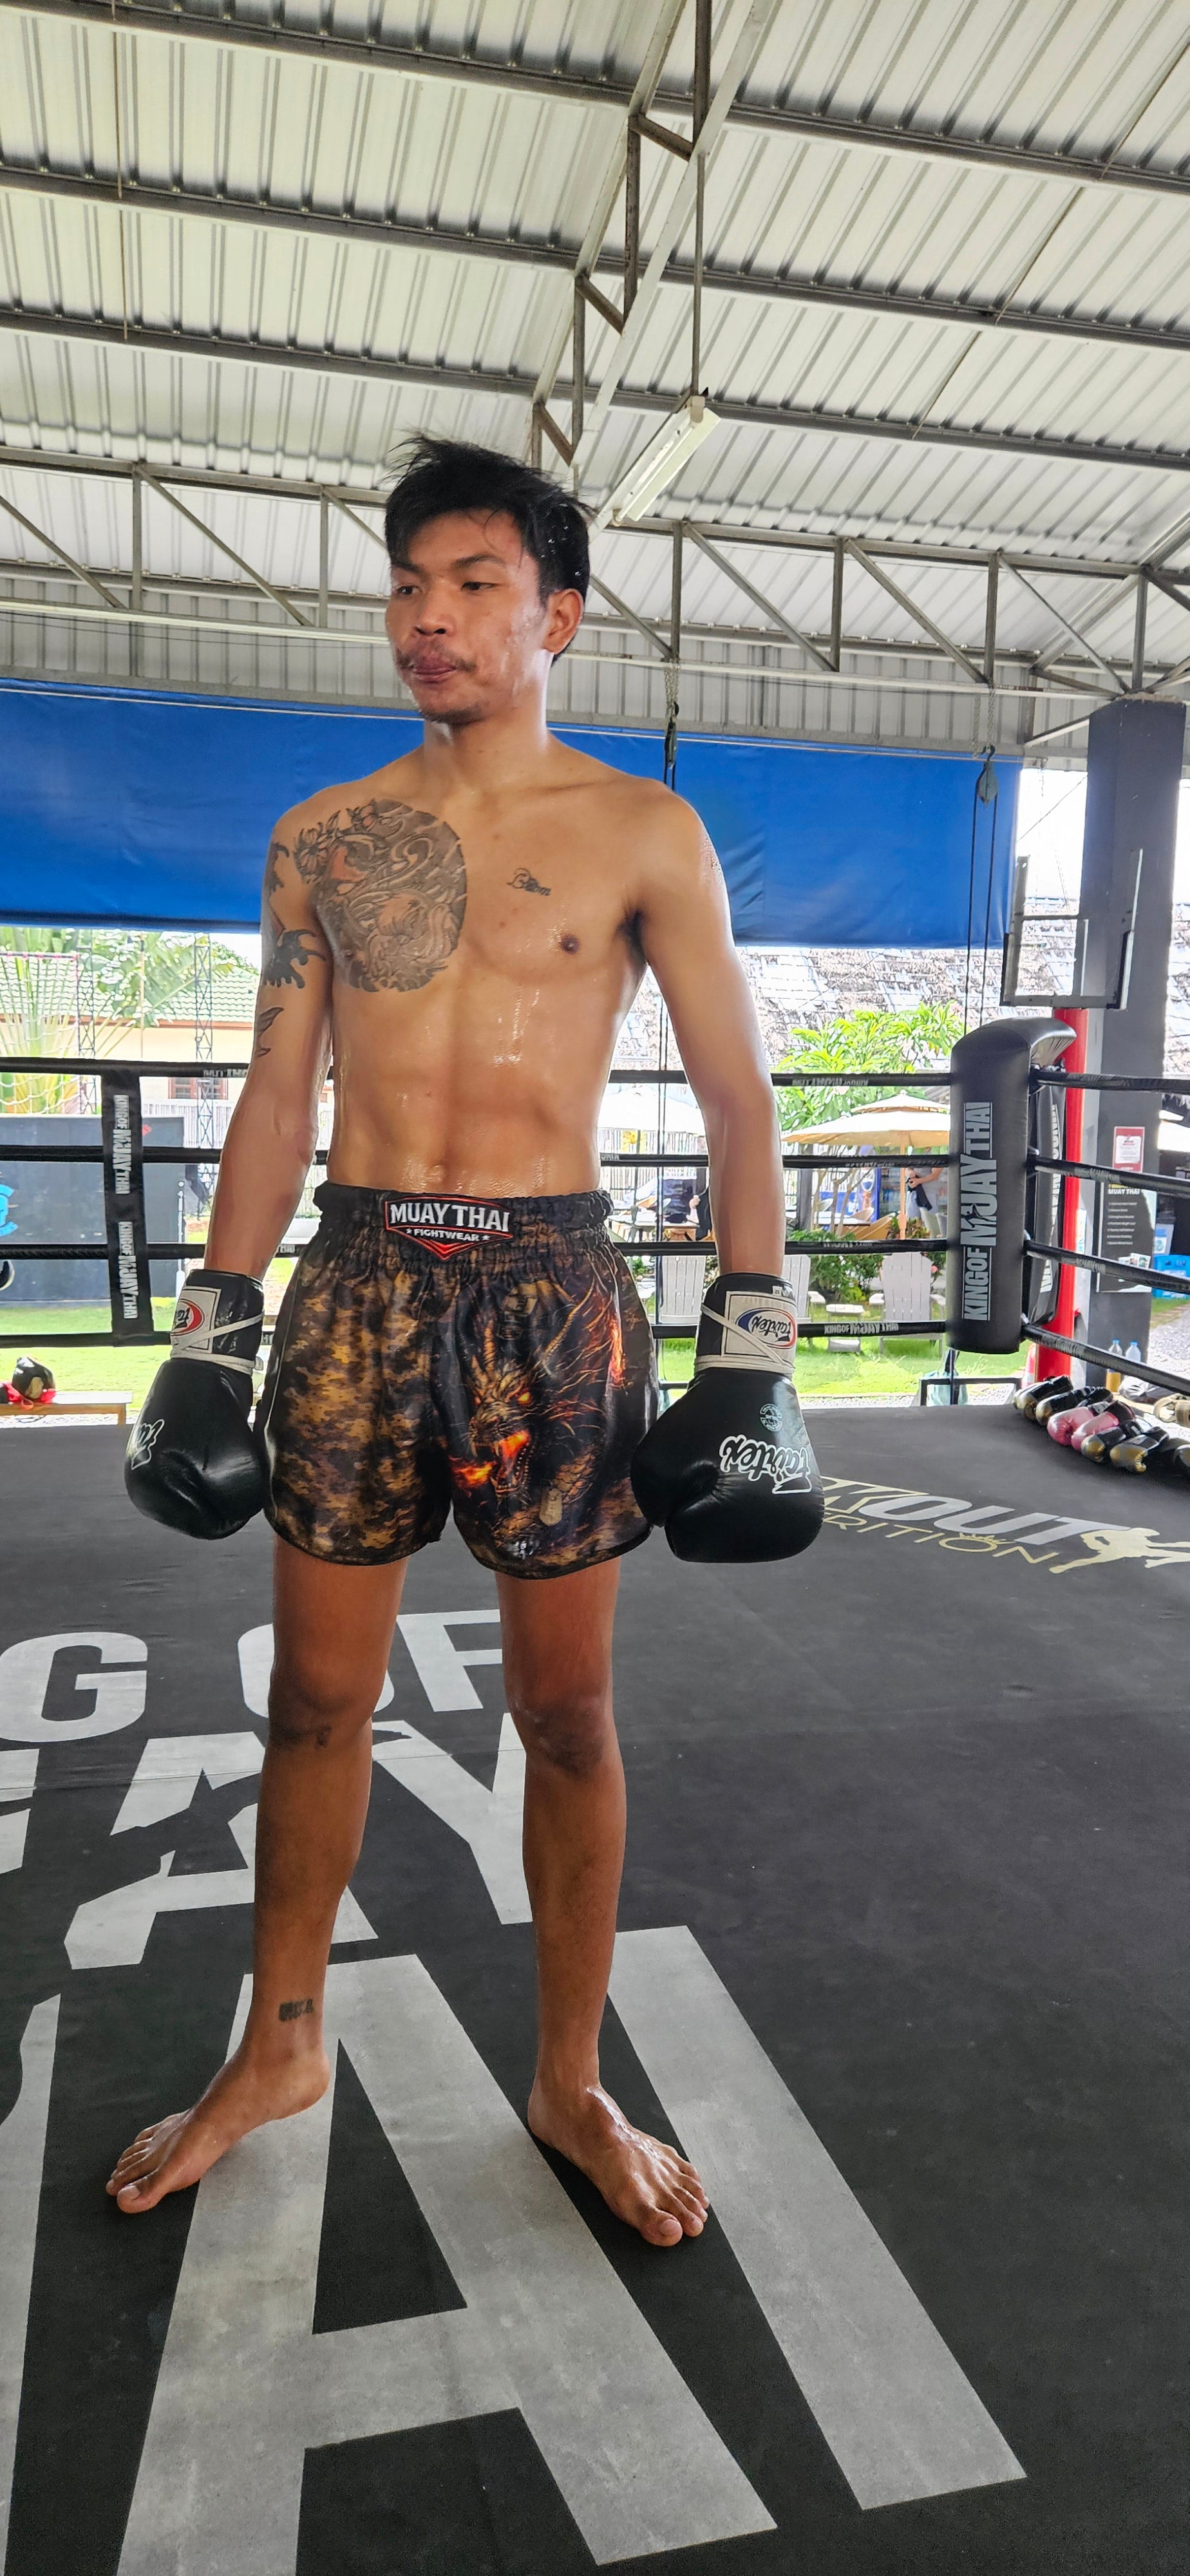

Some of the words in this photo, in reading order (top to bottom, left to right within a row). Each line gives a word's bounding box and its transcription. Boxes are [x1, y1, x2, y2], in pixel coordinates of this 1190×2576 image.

[965, 1102, 990, 1155] THAI
[960, 1154, 997, 1246] MUAY
[390, 1202, 451, 1225] MUAY
[451, 1205, 510, 1232] THAI
[414, 1229, 479, 1241] FIGHTWEAR
[751, 1316, 791, 1342] Fairtex
[850, 1323, 880, 1334] MUAY
[719, 1435, 812, 1494] Fairtex
